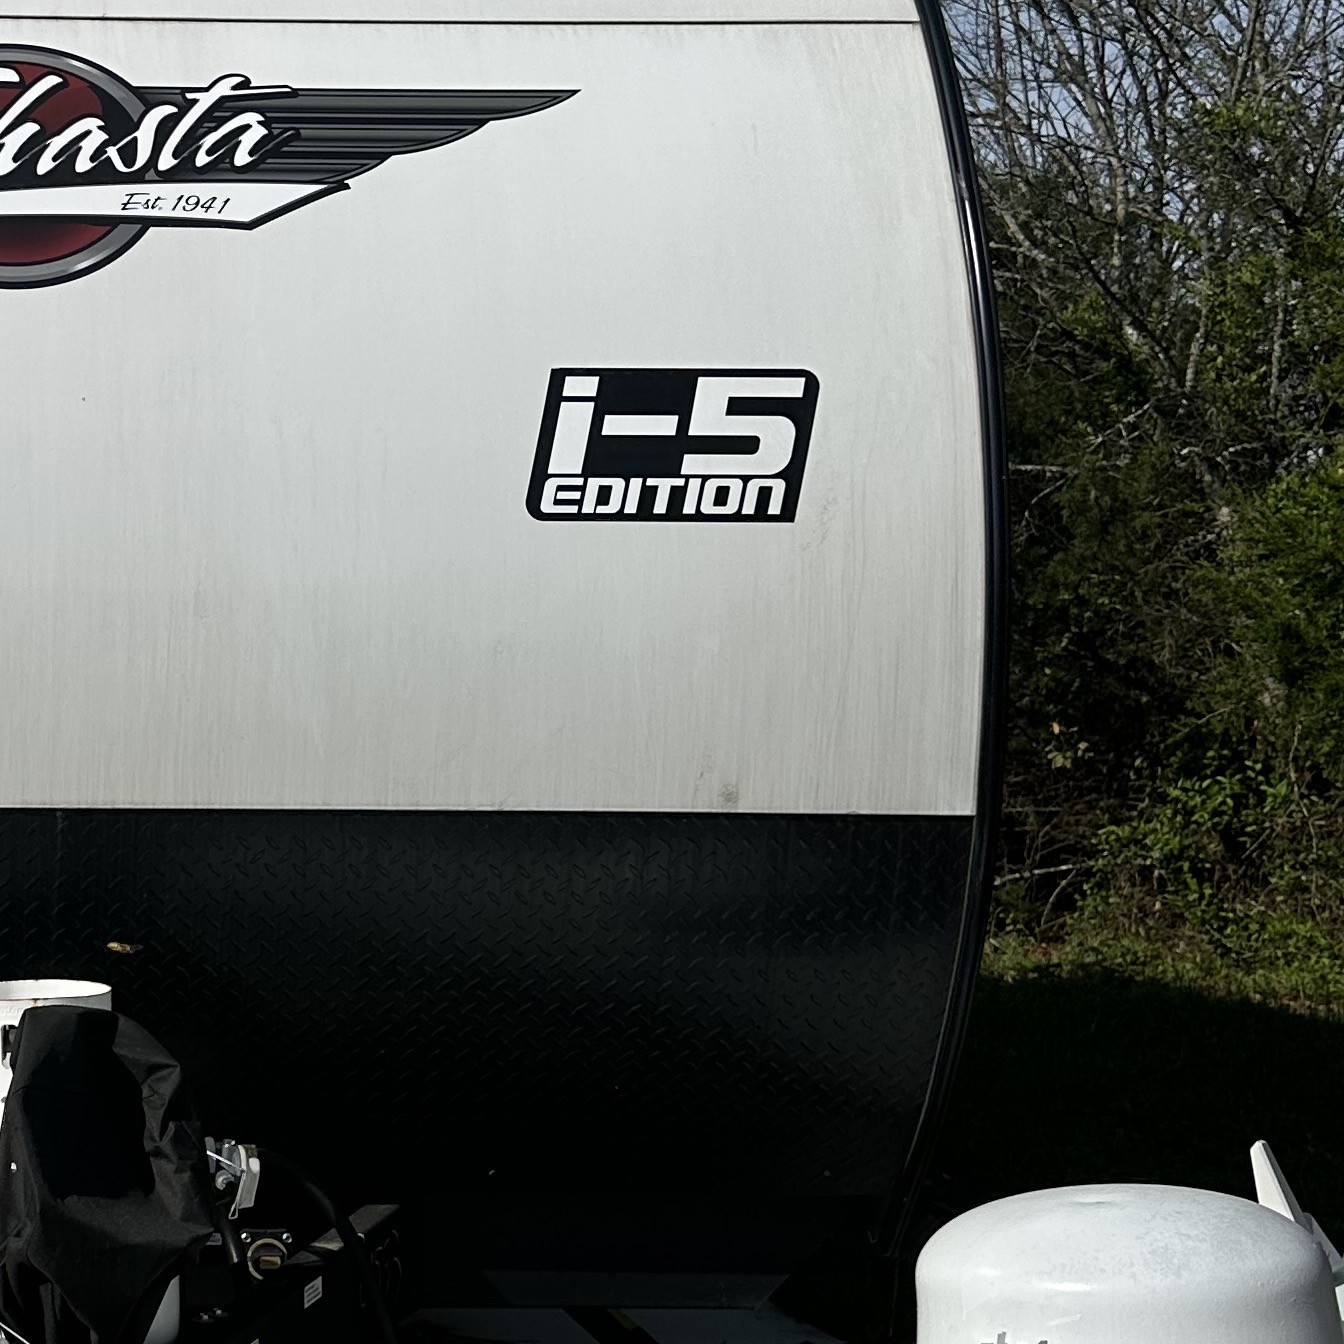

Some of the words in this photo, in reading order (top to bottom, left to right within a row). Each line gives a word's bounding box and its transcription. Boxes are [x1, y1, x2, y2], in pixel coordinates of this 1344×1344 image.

[121, 193, 167, 211] Est.
[172, 194, 231, 214] 1941
[547, 376, 806, 475] i-5
